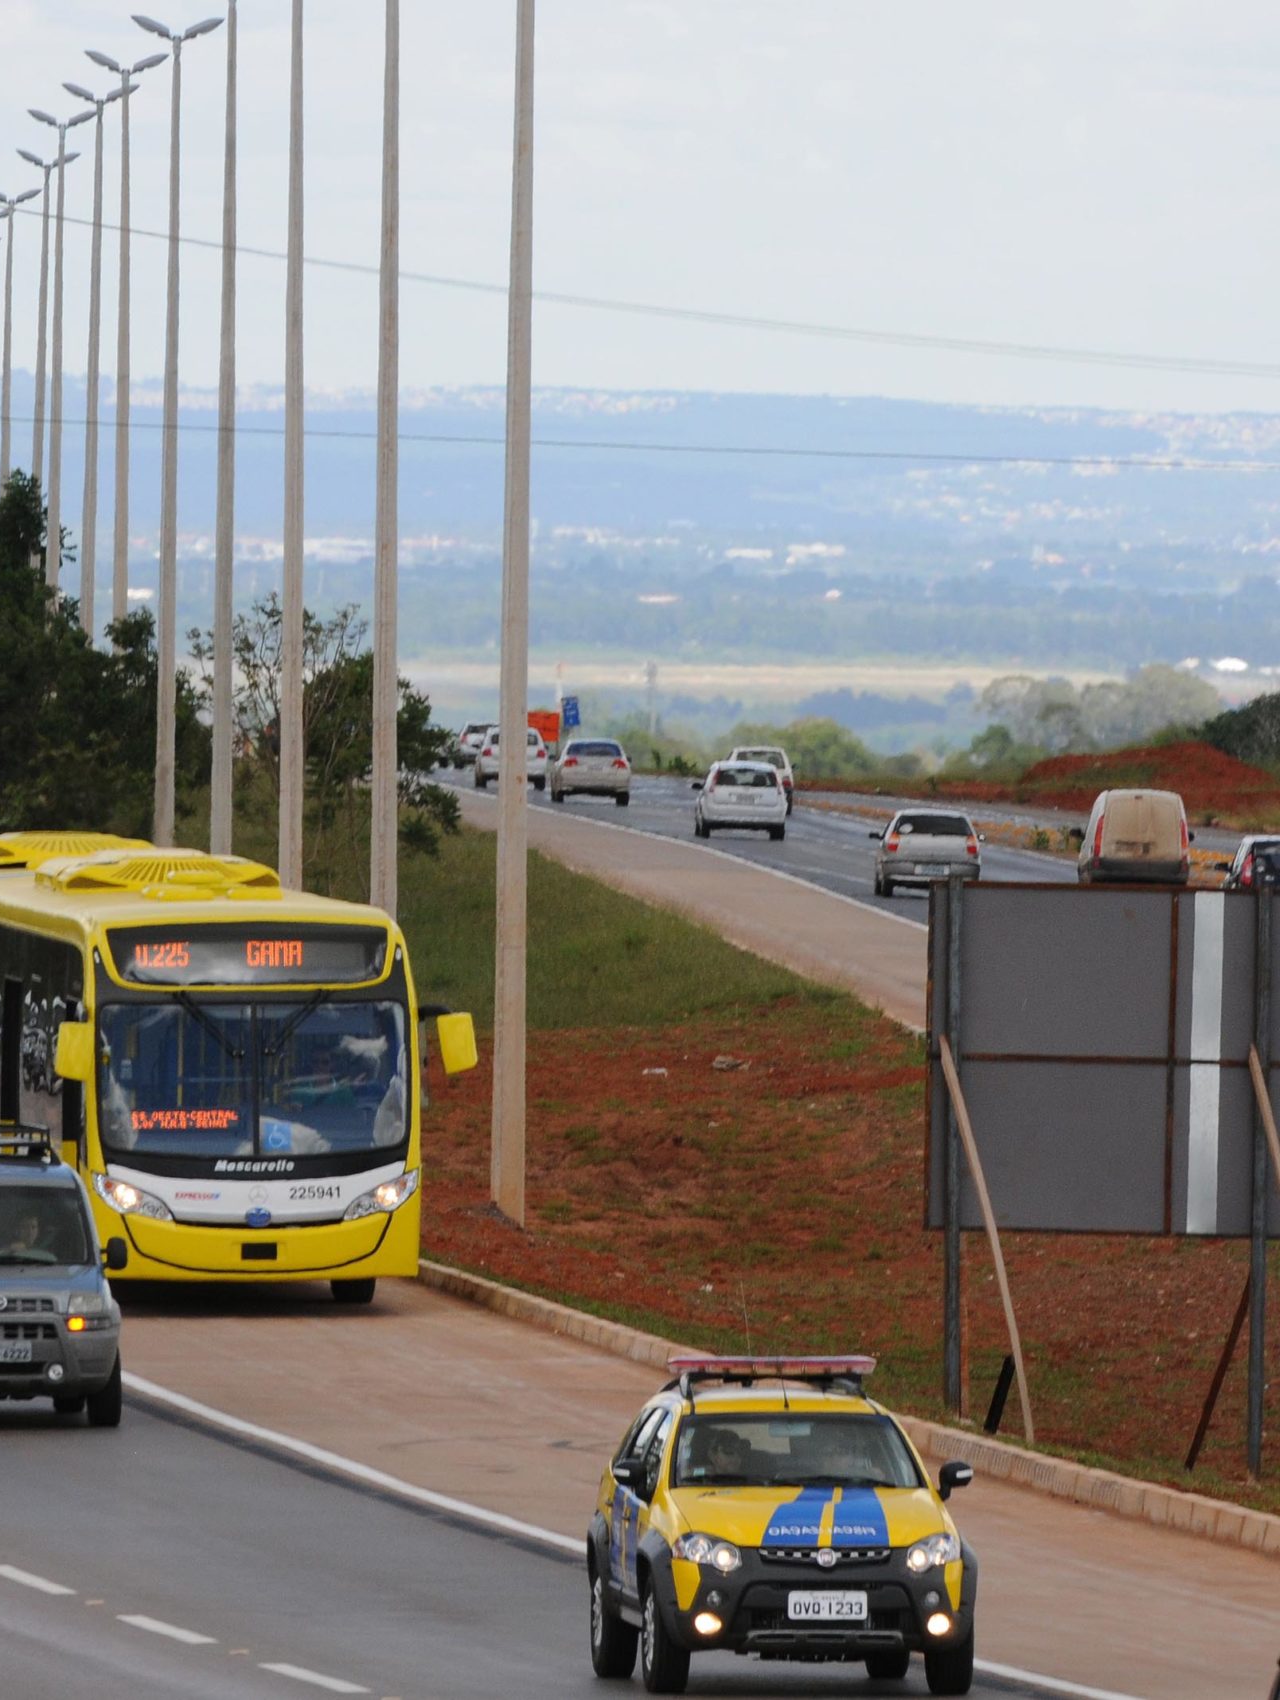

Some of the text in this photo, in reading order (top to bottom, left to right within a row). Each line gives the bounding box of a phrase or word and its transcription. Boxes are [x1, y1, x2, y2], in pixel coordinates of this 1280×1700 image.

[246, 940, 303, 967] GAMA
[214, 1159, 295, 1173] Mascarello
[289, 1186, 341, 1199] 225941
